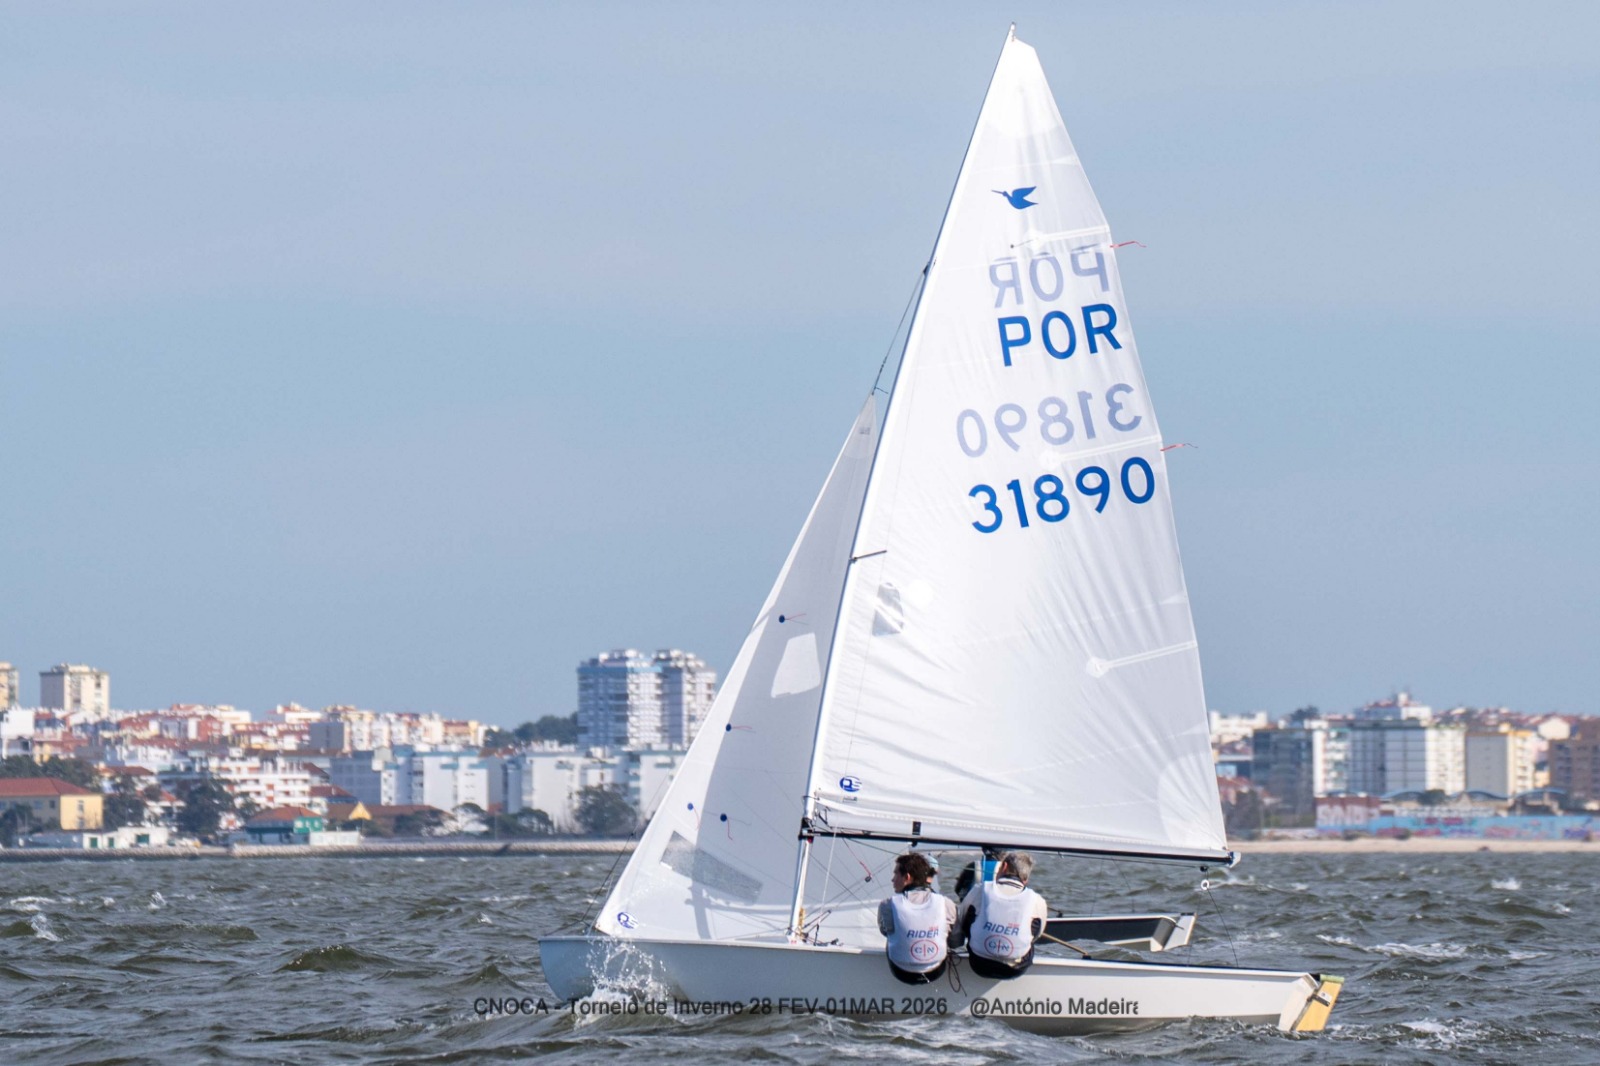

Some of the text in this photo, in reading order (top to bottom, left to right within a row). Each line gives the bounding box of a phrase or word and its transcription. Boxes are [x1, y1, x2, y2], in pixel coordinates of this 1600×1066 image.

[998, 303, 1122, 367] POR
[968, 456, 1155, 533] 31890
[906, 929, 939, 939] RIDER
[983, 921, 1020, 936] RIDER
